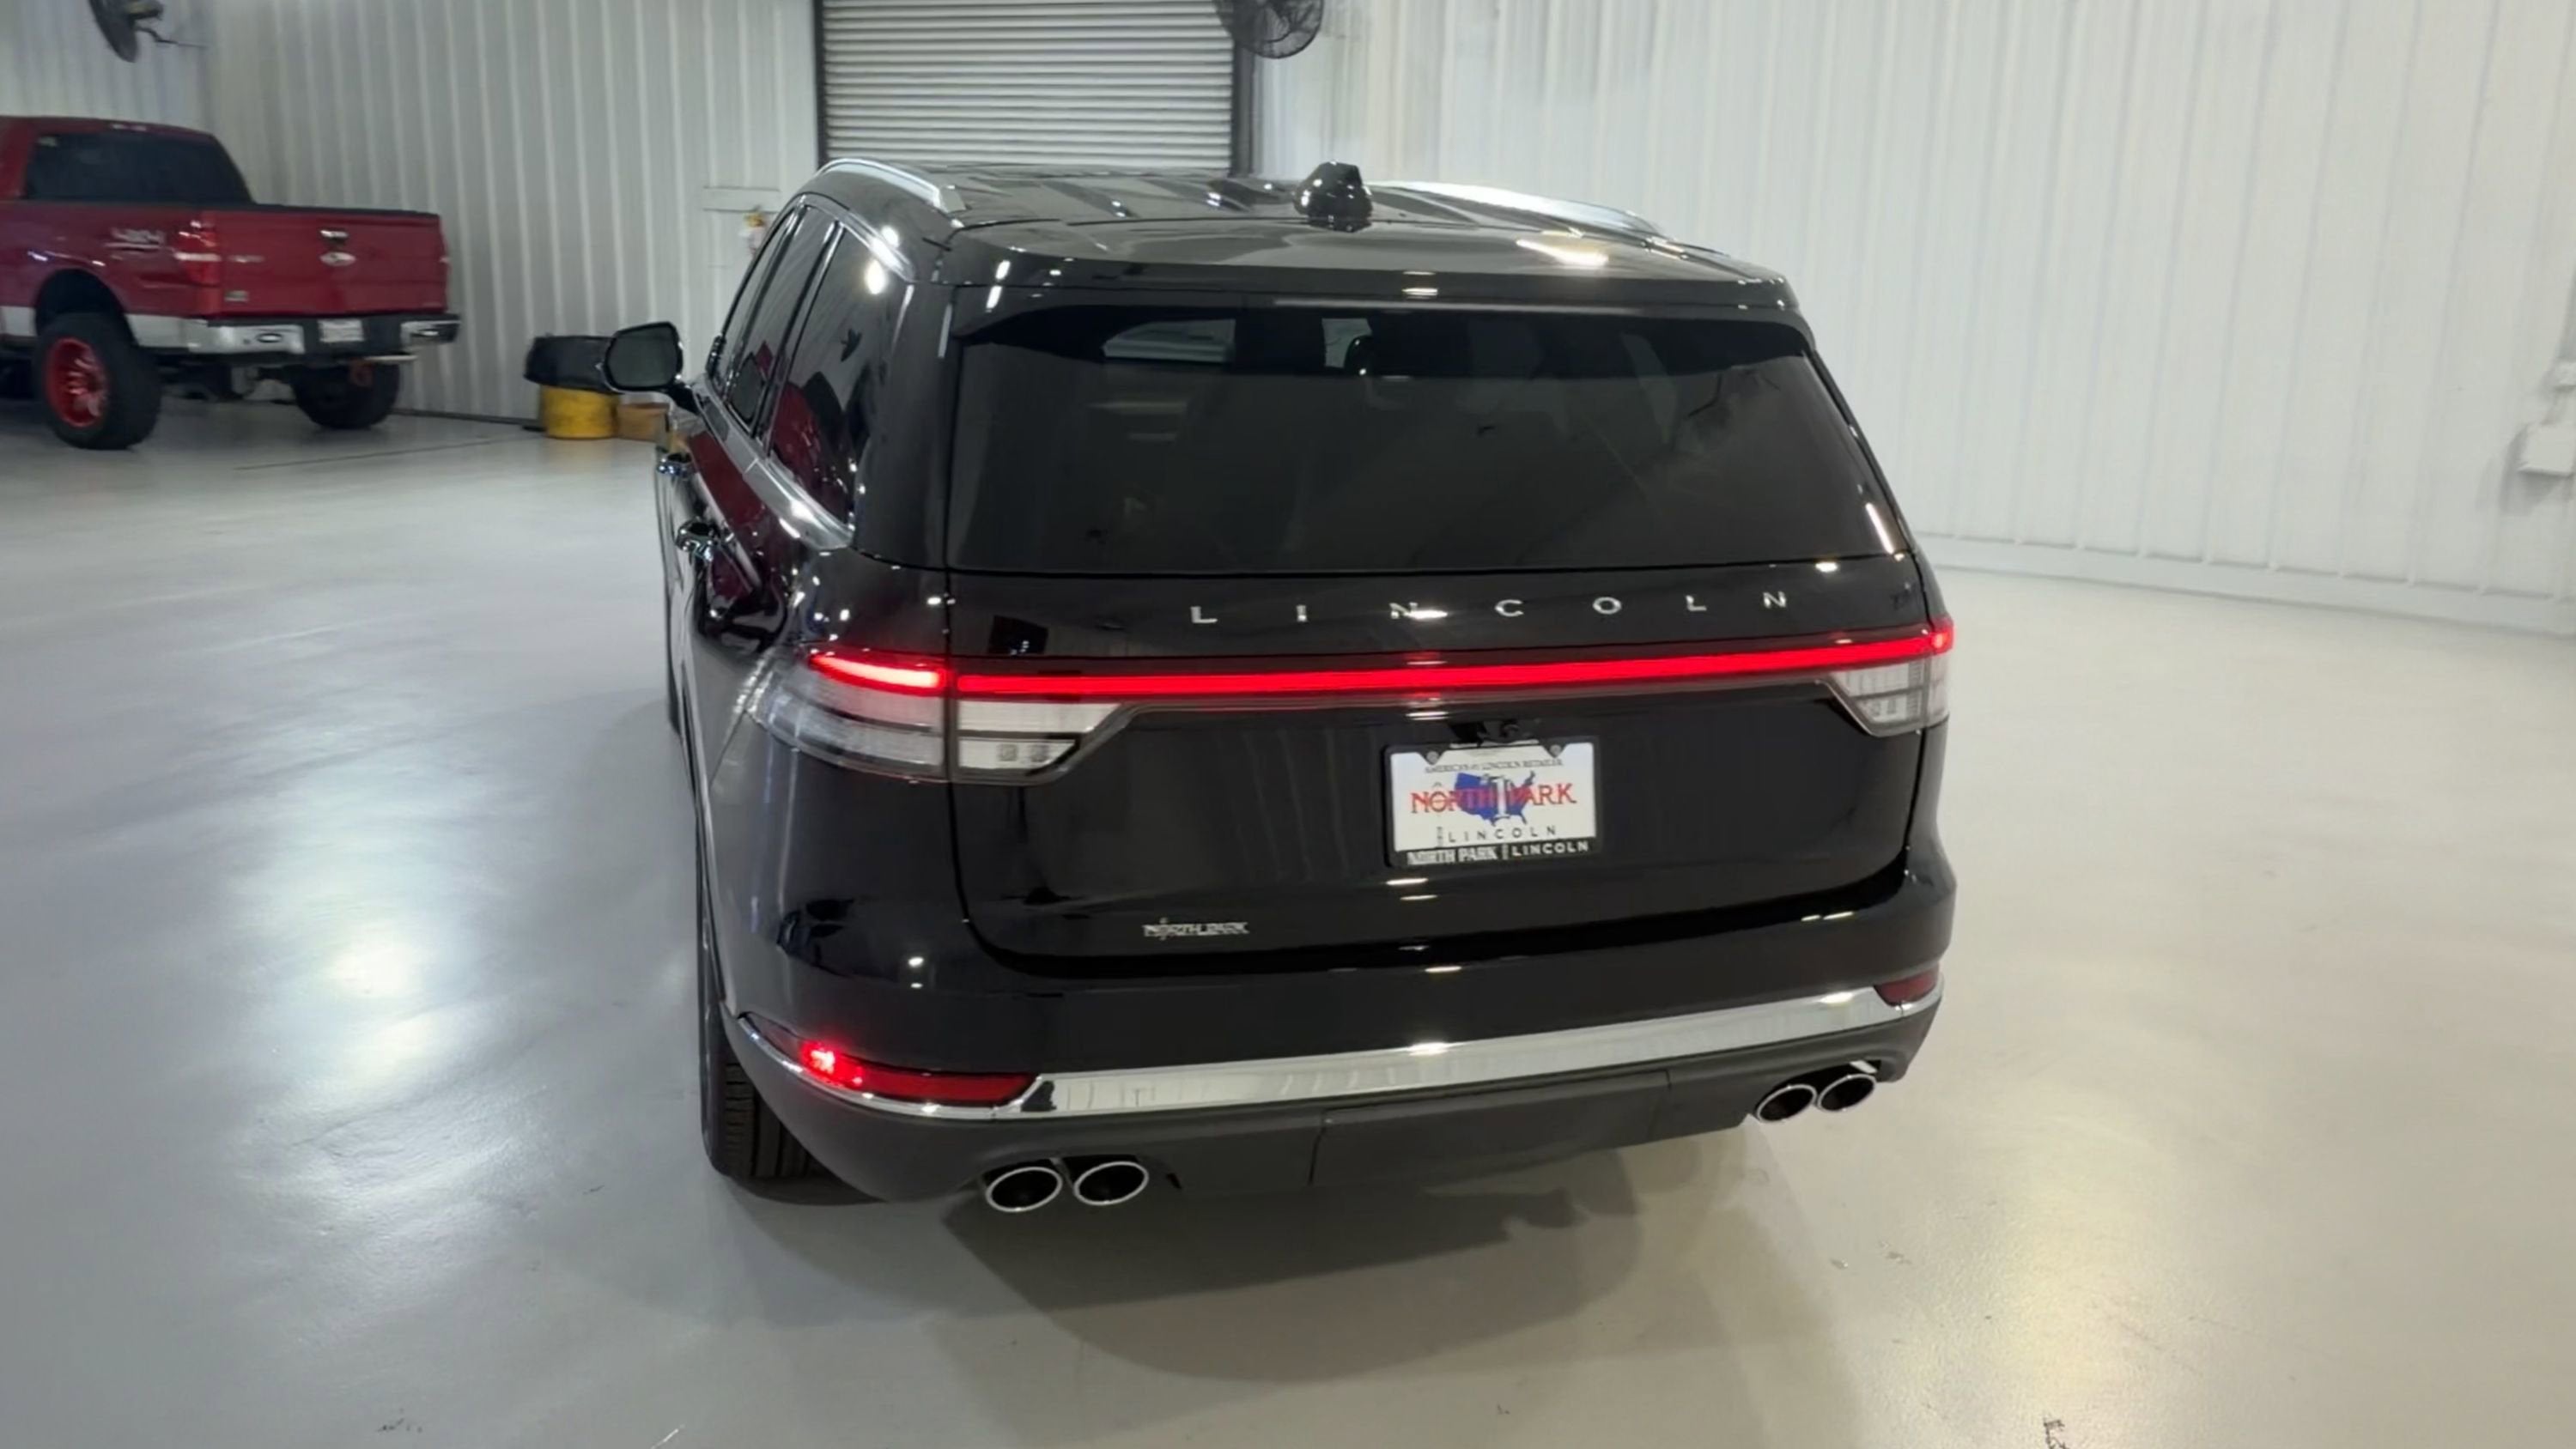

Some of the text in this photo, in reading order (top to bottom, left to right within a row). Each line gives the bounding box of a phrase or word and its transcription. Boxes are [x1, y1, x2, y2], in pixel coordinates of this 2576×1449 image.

[1190, 590, 1788, 623] LINCOLN
[1410, 784, 1577, 814] NORTH PARK
[1448, 825, 1557, 843] LINCOLN
[1458, 845, 1499, 863] PARK
[1510, 840, 1589, 858] LINCOLN
